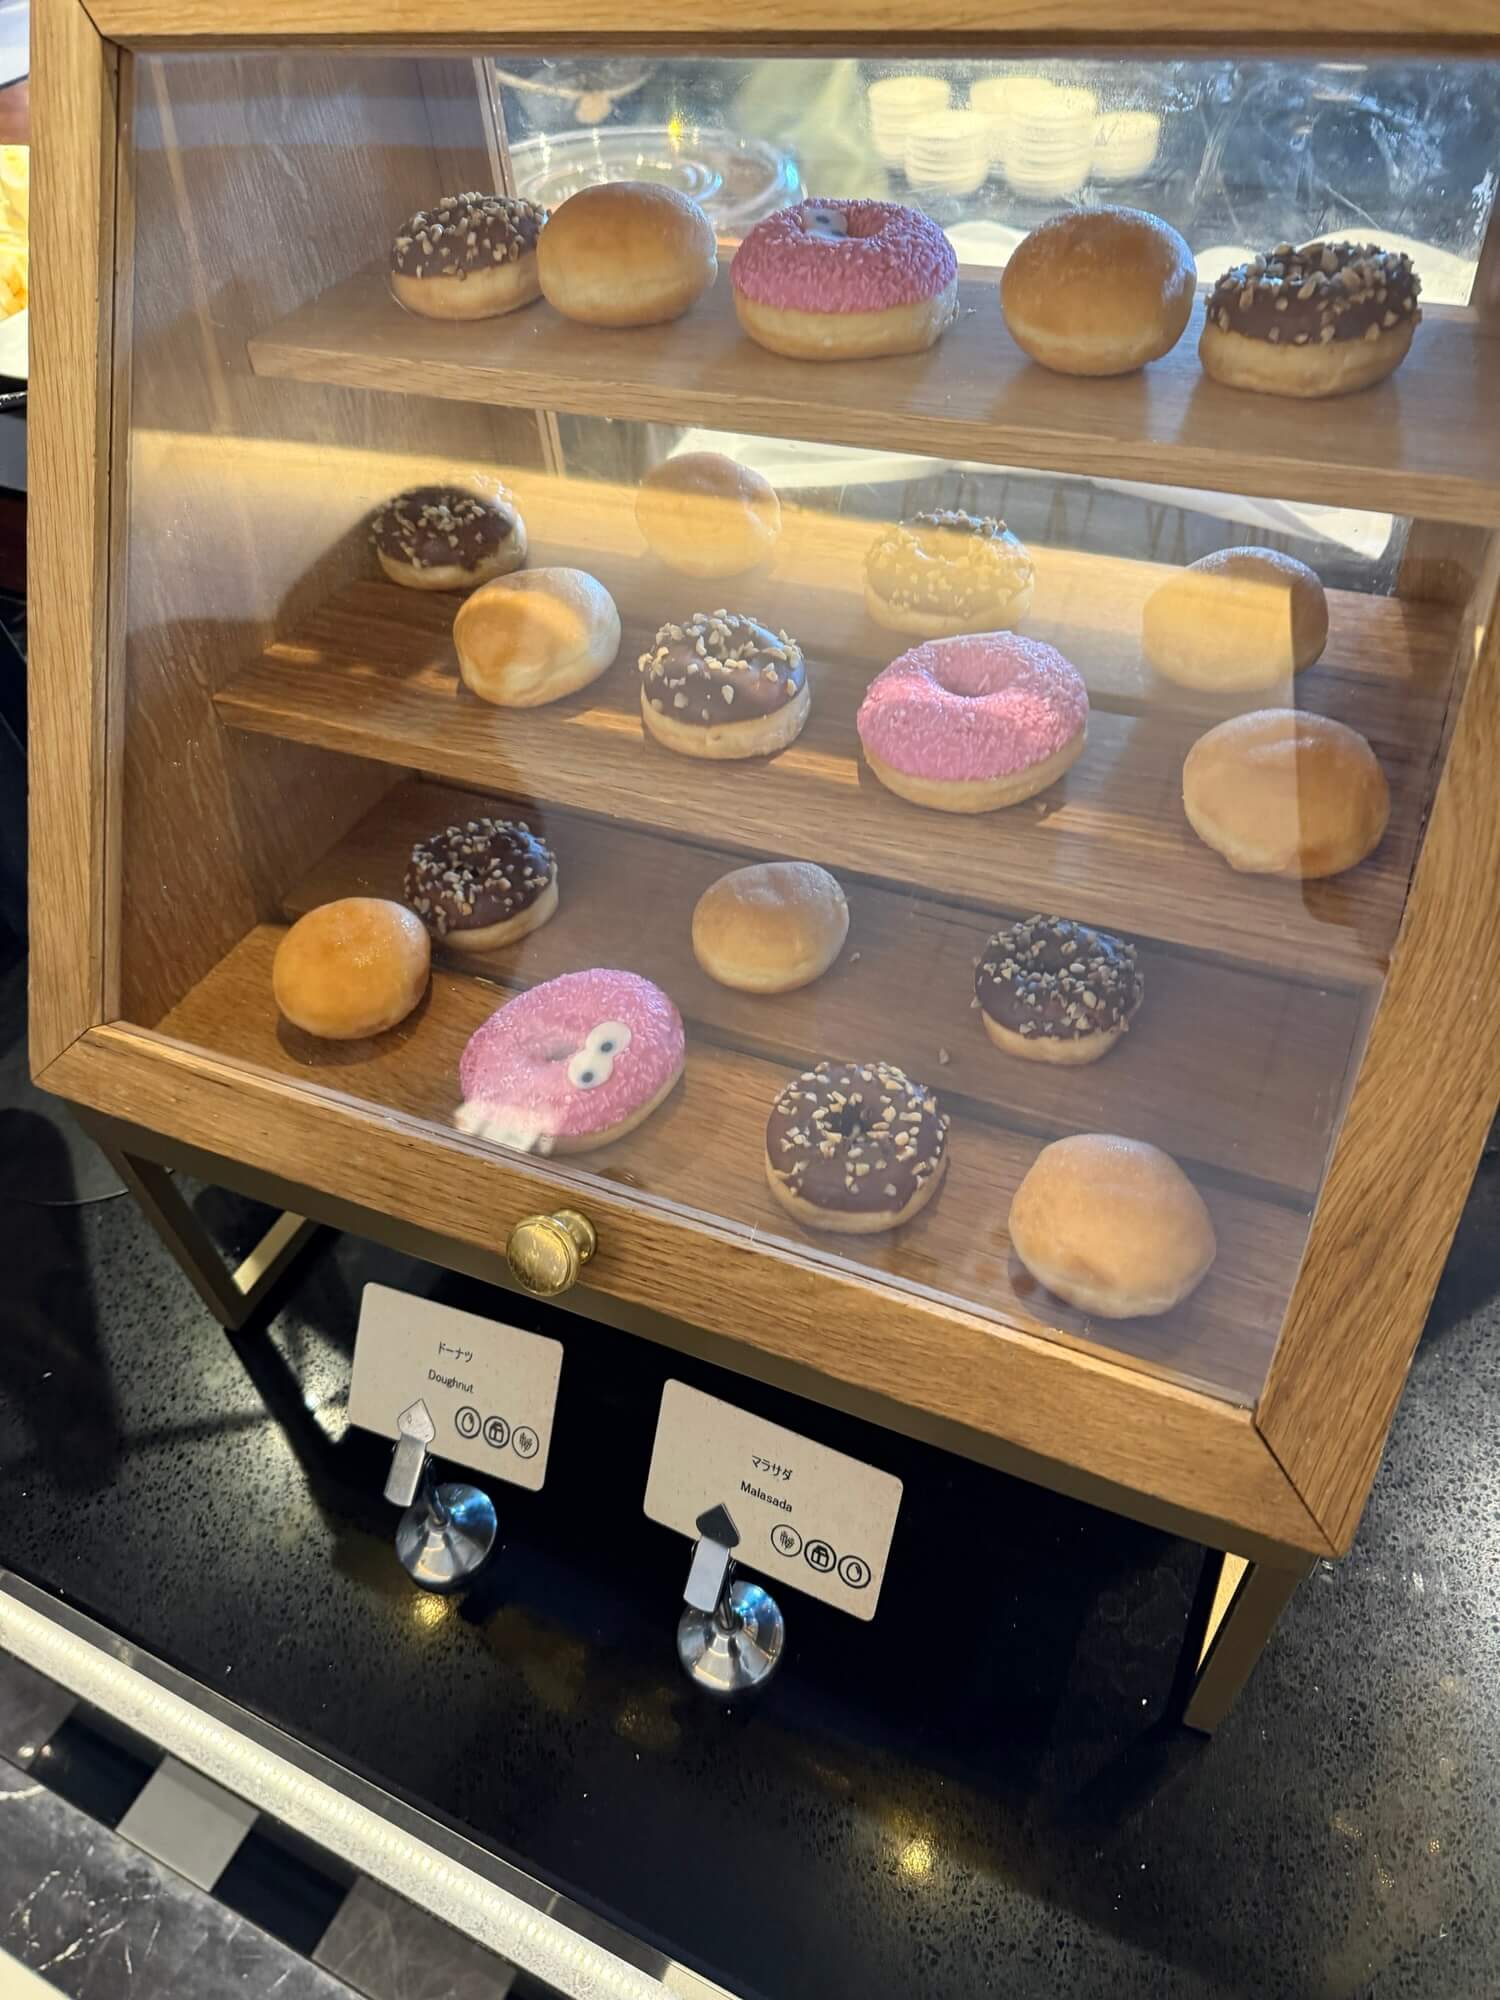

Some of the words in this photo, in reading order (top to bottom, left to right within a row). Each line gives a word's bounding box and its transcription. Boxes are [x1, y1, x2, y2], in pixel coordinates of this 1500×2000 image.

[438, 1341, 473, 1362] ドーナツ
[428, 1368, 474, 1394] Doughnut
[752, 1455, 793, 1481] マラサダ
[740, 1480, 793, 1513] Malasada
